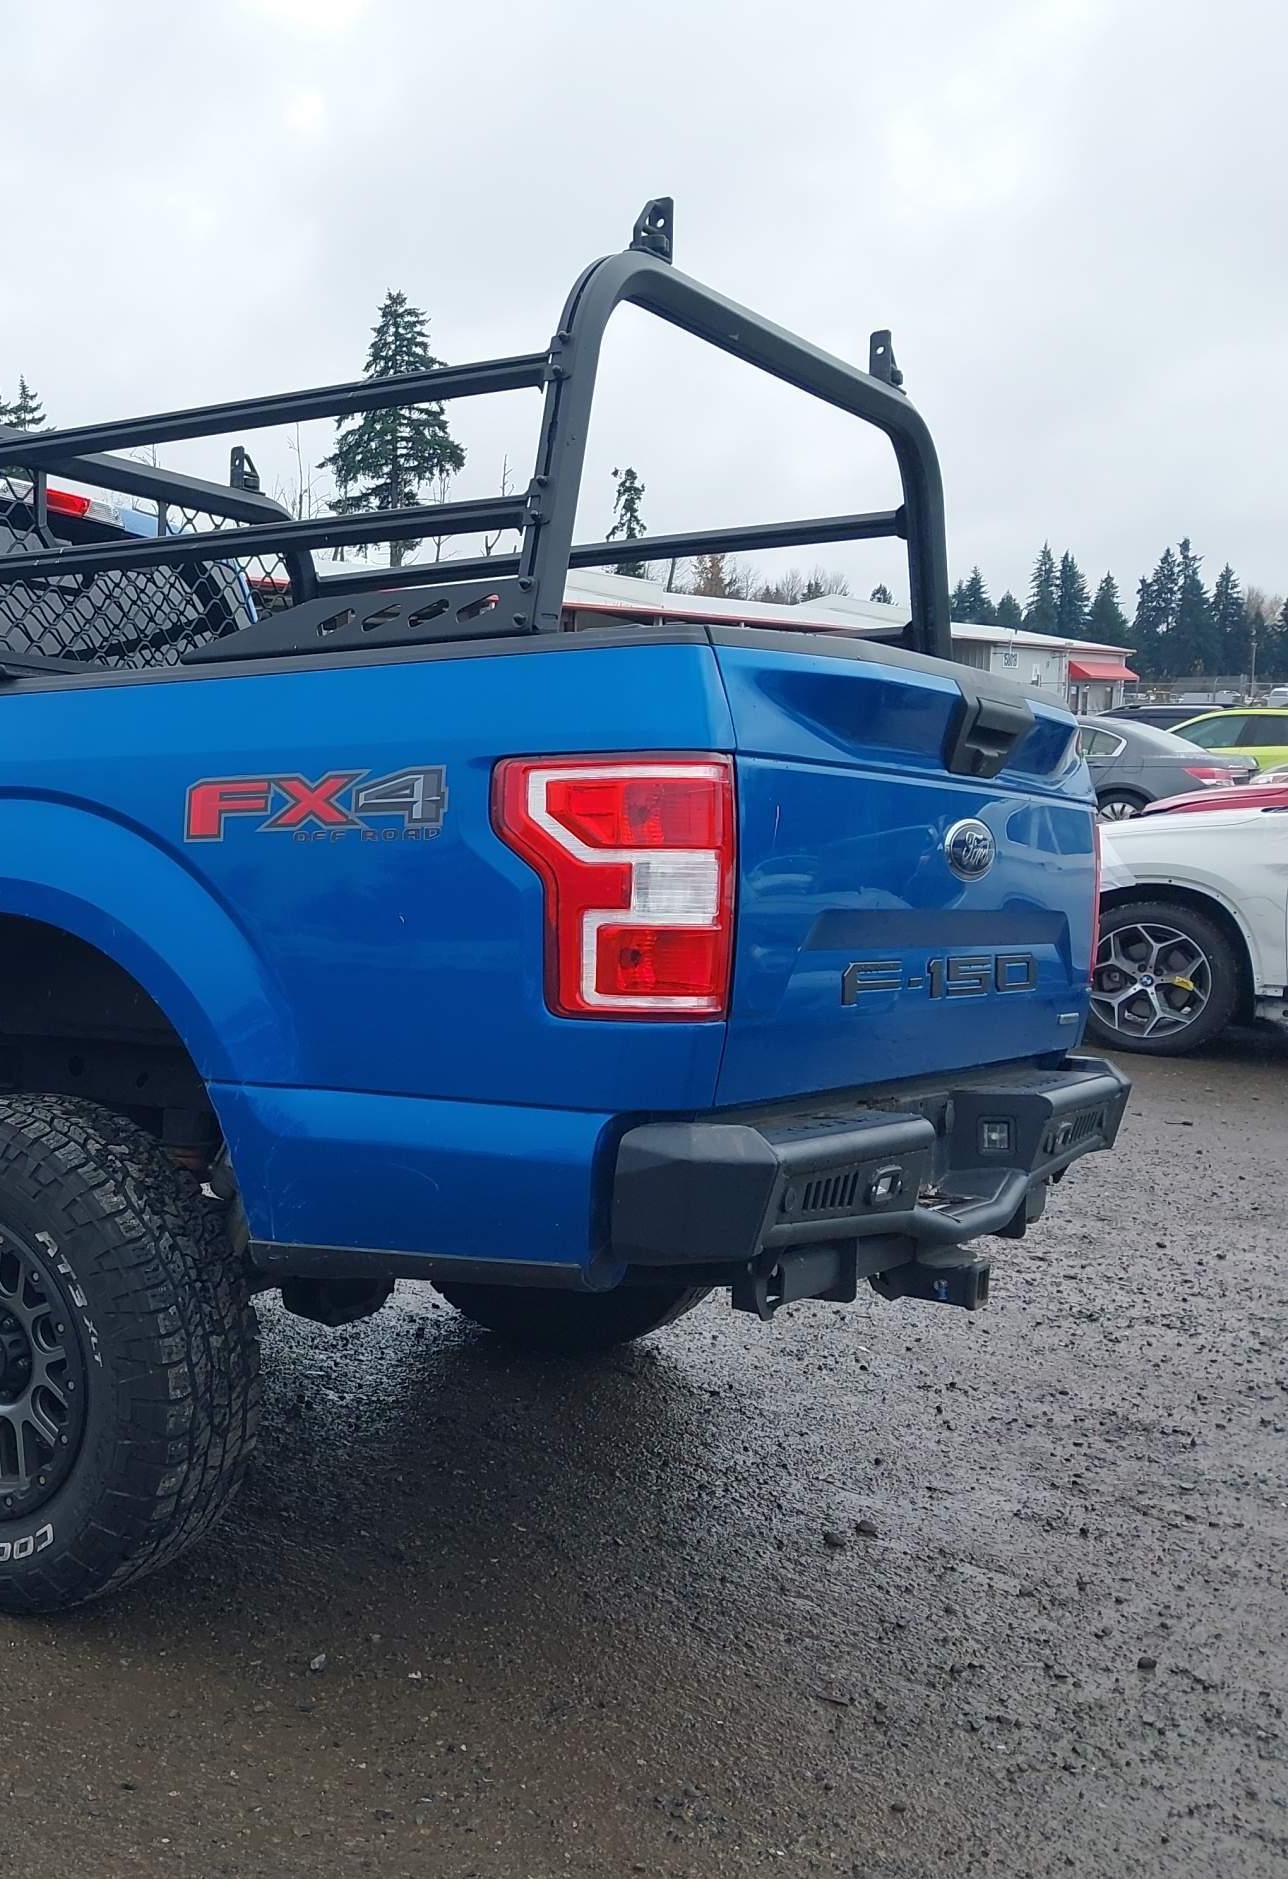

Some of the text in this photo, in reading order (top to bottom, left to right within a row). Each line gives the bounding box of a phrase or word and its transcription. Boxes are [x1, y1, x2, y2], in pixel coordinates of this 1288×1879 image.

[183, 764, 448, 843] FX4
[292, 826, 443, 843] OFF ROAD
[962, 831, 990, 865] Ford
[840, 953, 1037, 1007] F-150
[34, 1231, 88, 1308] AT3
